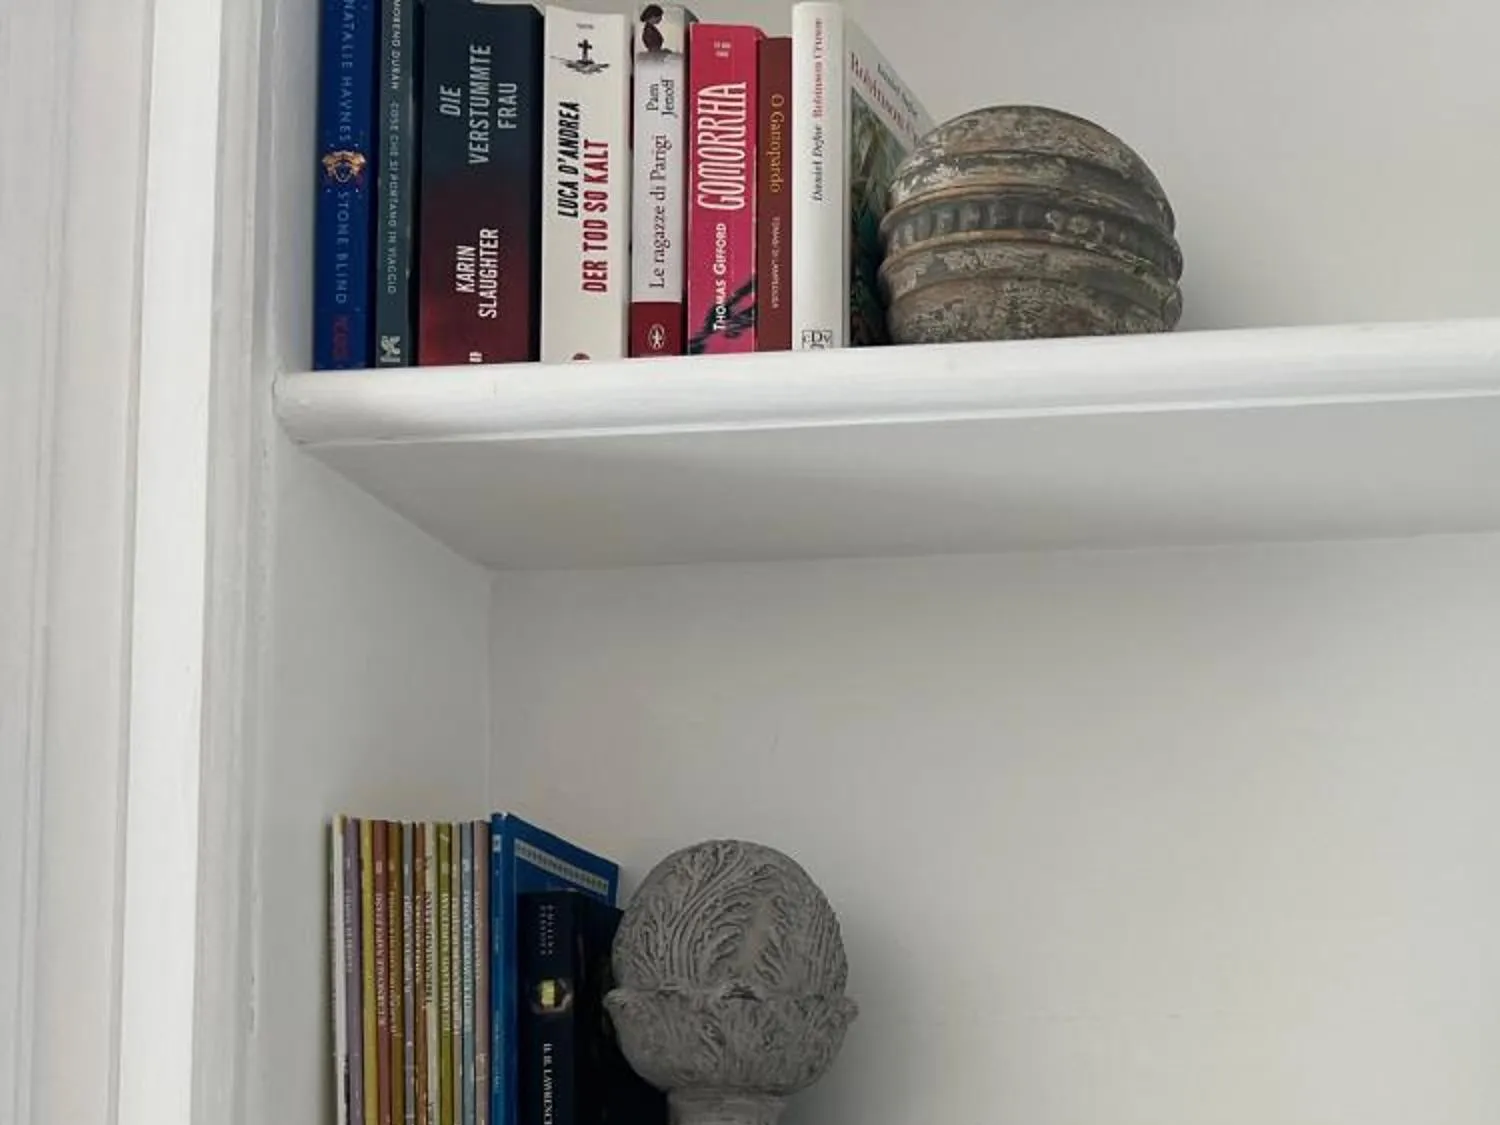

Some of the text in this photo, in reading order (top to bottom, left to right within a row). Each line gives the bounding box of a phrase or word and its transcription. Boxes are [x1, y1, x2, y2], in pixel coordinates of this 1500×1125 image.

[339, 0, 357, 142] NATALIE HAYNES
[440, 85, 462, 117] DIE
[468, 44, 492, 165] VERSTUMMTE
[497, 82, 518, 129] FRAU
[646, 83, 659, 112] Pam
[661, 79, 677, 118] Jenoff
[769, 94, 785, 107] O
[557, 101, 581, 219] LUCA D'ANDREA
[698, 82, 747, 211] GOMORRHA
[811, 161, 823, 202] Daniel
[336, 192, 350, 244] STONE
[387, 231, 397, 243] IN
[582, 139, 609, 293] DER TOD SO KALT
[649, 134, 673, 289] Le ragazze di Parigi
[335, 253, 349, 304] BLIND
[387, 247, 397, 294] VIAGGIO
[456, 245, 476, 293] KARIN
[478, 228, 499, 319] SLAUGHTER
[713, 222, 728, 331] THOMAS GIFFORD
